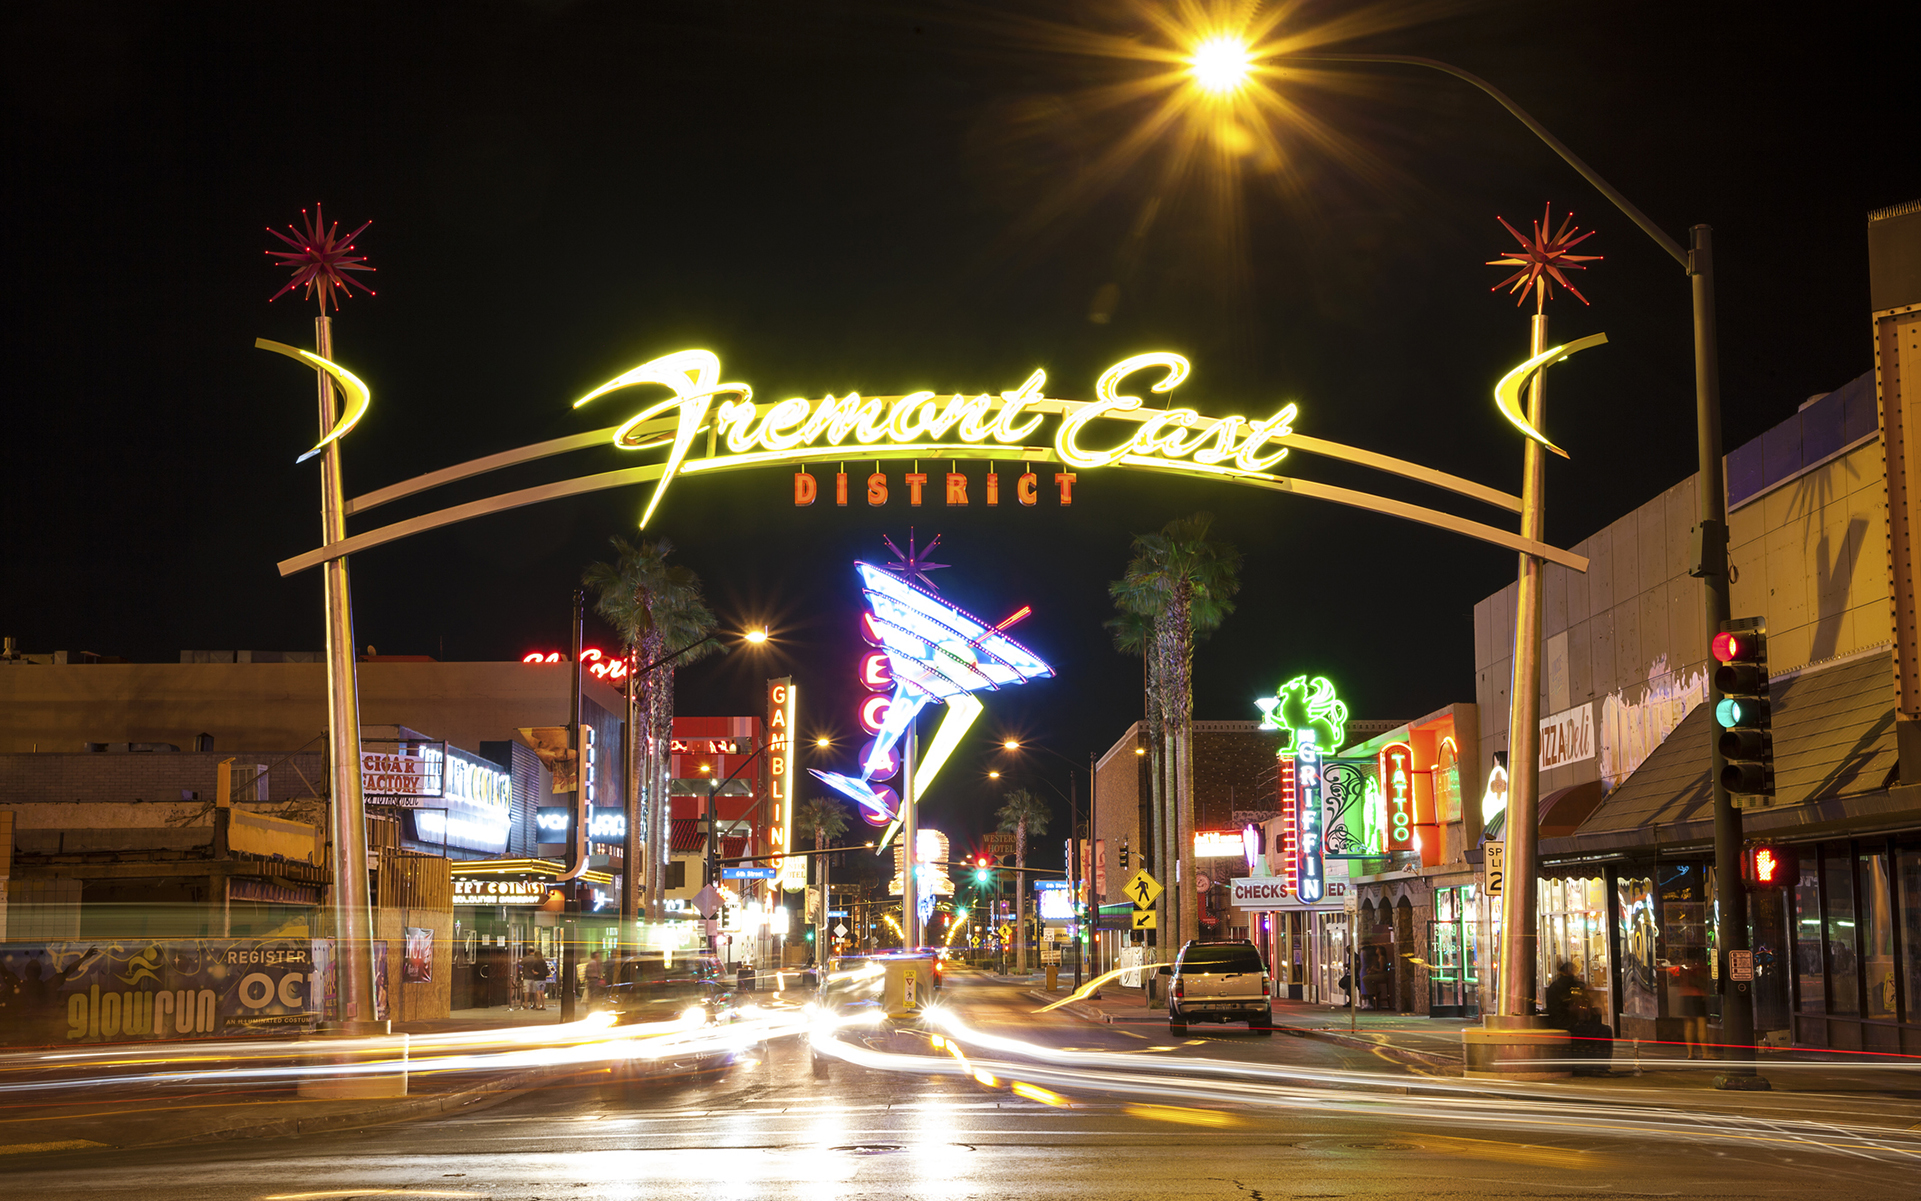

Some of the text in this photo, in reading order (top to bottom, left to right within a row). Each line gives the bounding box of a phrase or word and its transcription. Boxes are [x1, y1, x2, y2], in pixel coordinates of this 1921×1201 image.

[572, 348, 1298, 530] Fremont East
[795, 472, 1078, 506] DISTRICT
[1566, 706, 1590, 760] Deli
[363, 754, 416, 774] CIGAR
[770, 685, 786, 868] GAMBLING
[1391, 754, 1410, 841] TATTOO
[1298, 743, 1320, 899] GRIFFIN
[988, 844, 1015, 853] HOTEL
[747, 870, 764, 878] Street
[1489, 871, 1503, 891] 2
[1543, 866, 1596, 877] BURGERS
[455, 882, 484, 894] ERT
[1235, 884, 1289, 900] CHECKS
[227, 950, 307, 964] REGISTER
[238, 971, 313, 1010] OC
[66, 983, 216, 1041] glowrun
[284, 1016, 311, 1024] COSTUM
